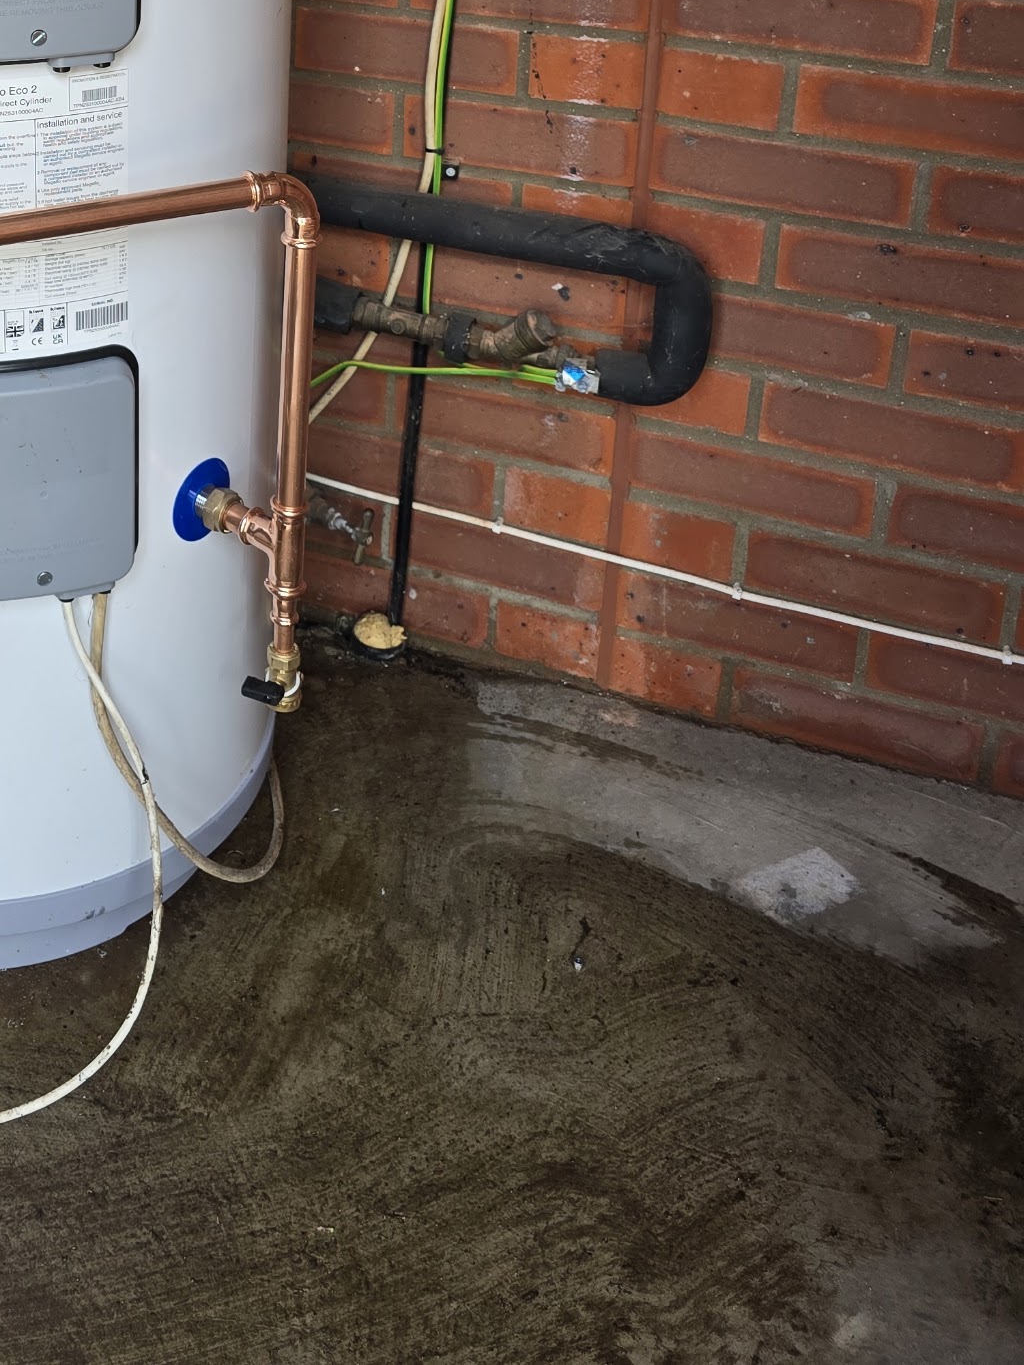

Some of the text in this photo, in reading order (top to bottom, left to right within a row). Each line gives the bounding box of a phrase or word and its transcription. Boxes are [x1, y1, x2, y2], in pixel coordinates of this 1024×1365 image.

[9, 86, 28, 96] Eco
[31, 84, 38, 94] 2
[20, 96, 52, 108] Cylinder
[37, 111, 123, 129] Installation and service
